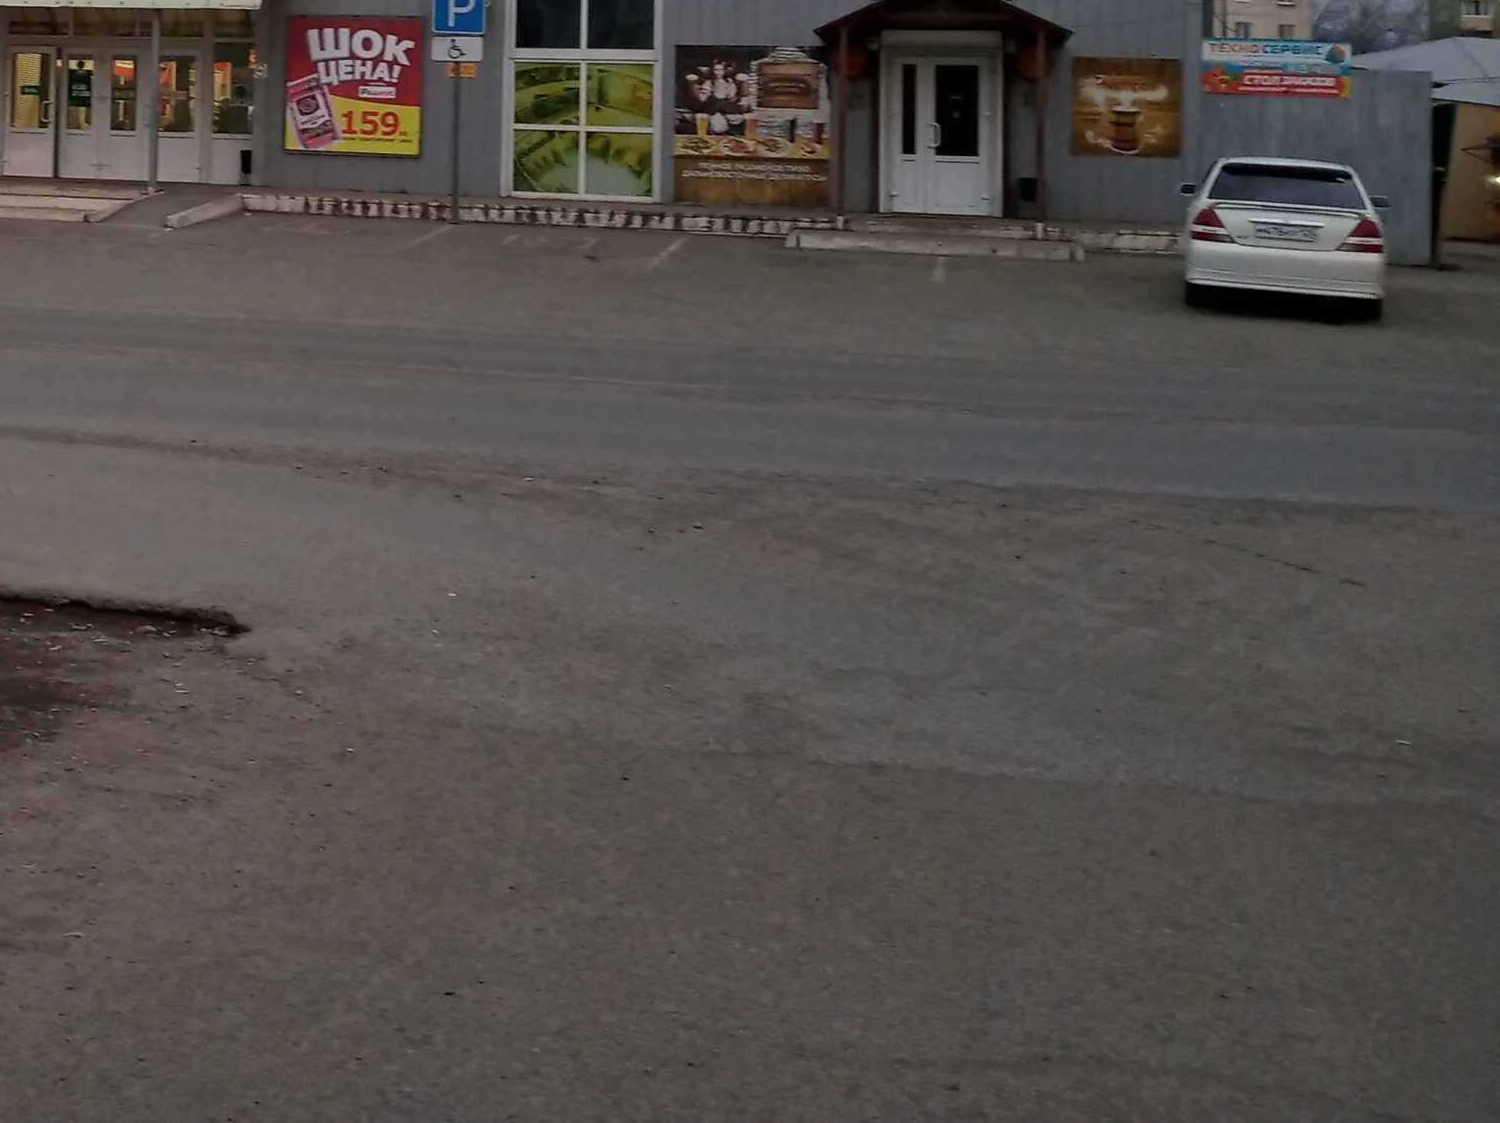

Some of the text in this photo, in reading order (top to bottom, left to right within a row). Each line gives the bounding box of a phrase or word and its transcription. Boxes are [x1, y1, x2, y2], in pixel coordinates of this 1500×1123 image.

[307, 27, 416, 66] ШОК
[317, 59, 402, 86] ЦЕНА!
[341, 110, 401, 137] 159
